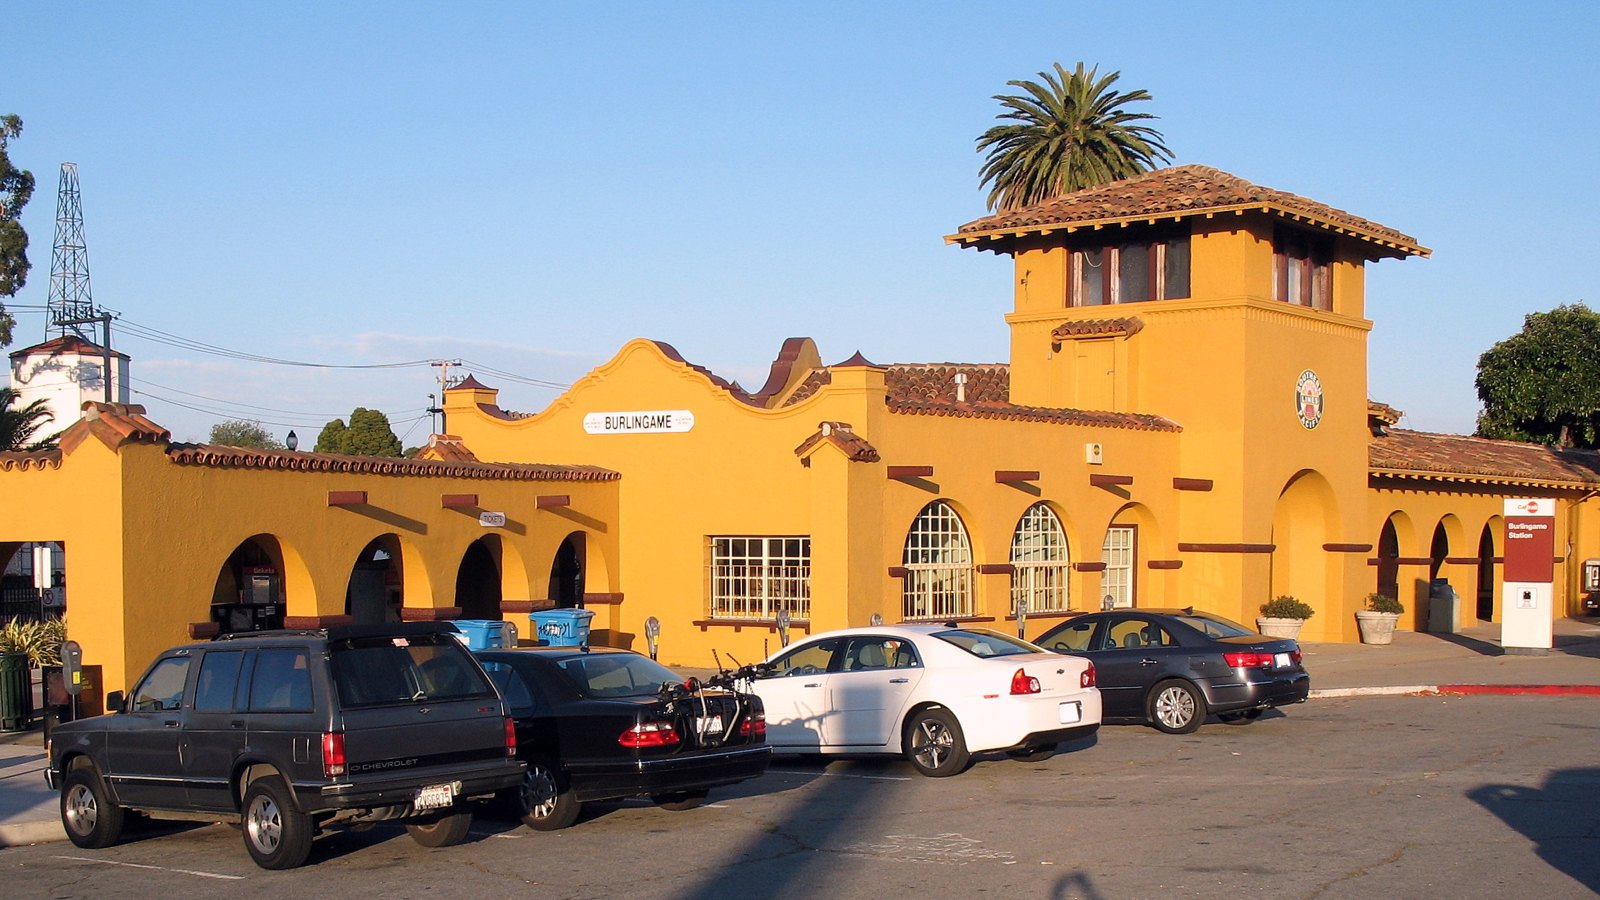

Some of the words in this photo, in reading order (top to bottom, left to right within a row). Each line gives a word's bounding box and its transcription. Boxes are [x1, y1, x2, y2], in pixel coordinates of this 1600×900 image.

[605, 415, 672, 430] BURLINGAME
[1298, 409, 1322, 429] PACIFIC
[1508, 523, 1548, 531] Burlingame
[362, 758, 419, 771] CHEVROLET
